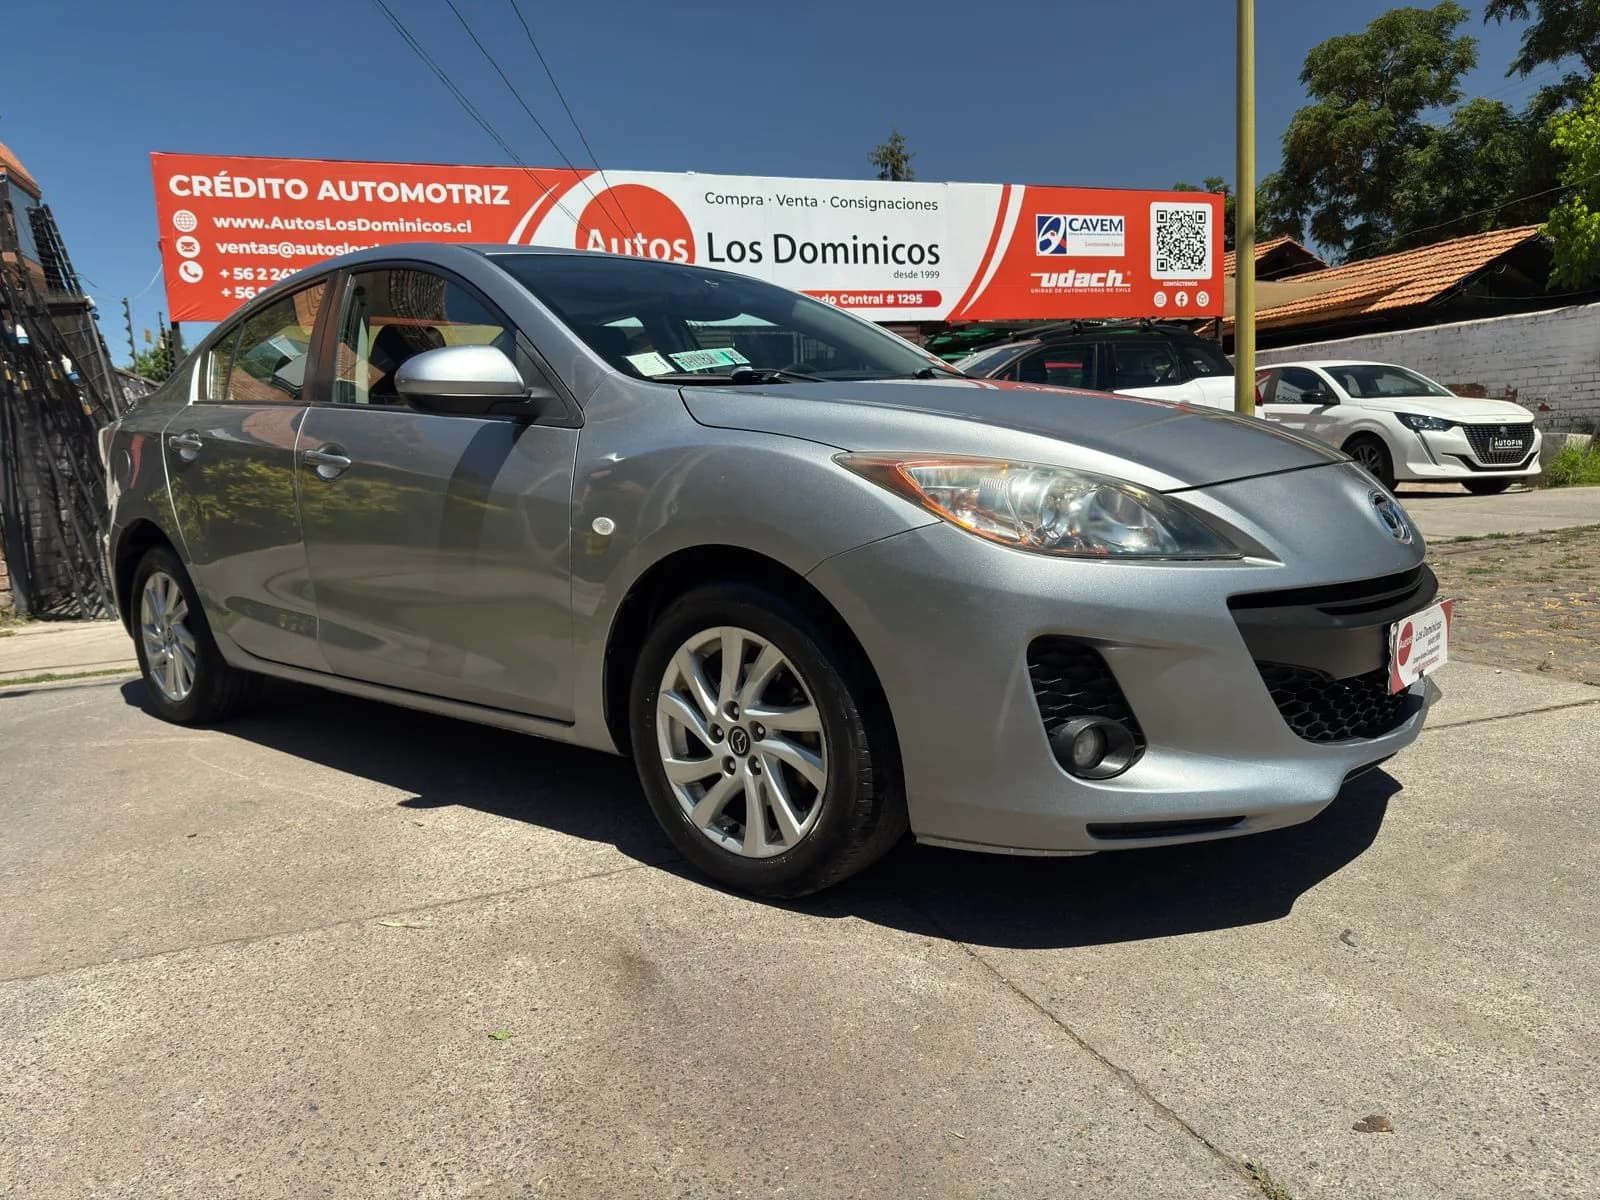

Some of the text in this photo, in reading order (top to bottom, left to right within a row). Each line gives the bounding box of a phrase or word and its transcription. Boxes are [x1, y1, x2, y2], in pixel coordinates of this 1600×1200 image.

[169, 170, 510, 206] CRÉDITO AUTOMOTRIZ
[705, 192, 764, 208] Compra
[776, 194, 818, 208] Venta
[830, 196, 939, 212] Consignaciones
[213, 216, 472, 234] www.AutosLosDominicos.cl
[1068, 217, 1123, 233] CAVEM
[587, 229, 689, 264] Autos
[707, 232, 940, 265] Los Dominicos
[233, 267, 254, 281] 56
[256, 268, 268, 281] 2
[893, 270, 940, 279] desde 1999
[1030, 269, 1132, 288] udach
[235, 286, 256, 299] 56
[840, 294, 883, 305] Central
[886, 294, 895, 304] #
[897, 294, 923, 305] 1295
[1494, 438, 1523, 447] AUTOFIN
